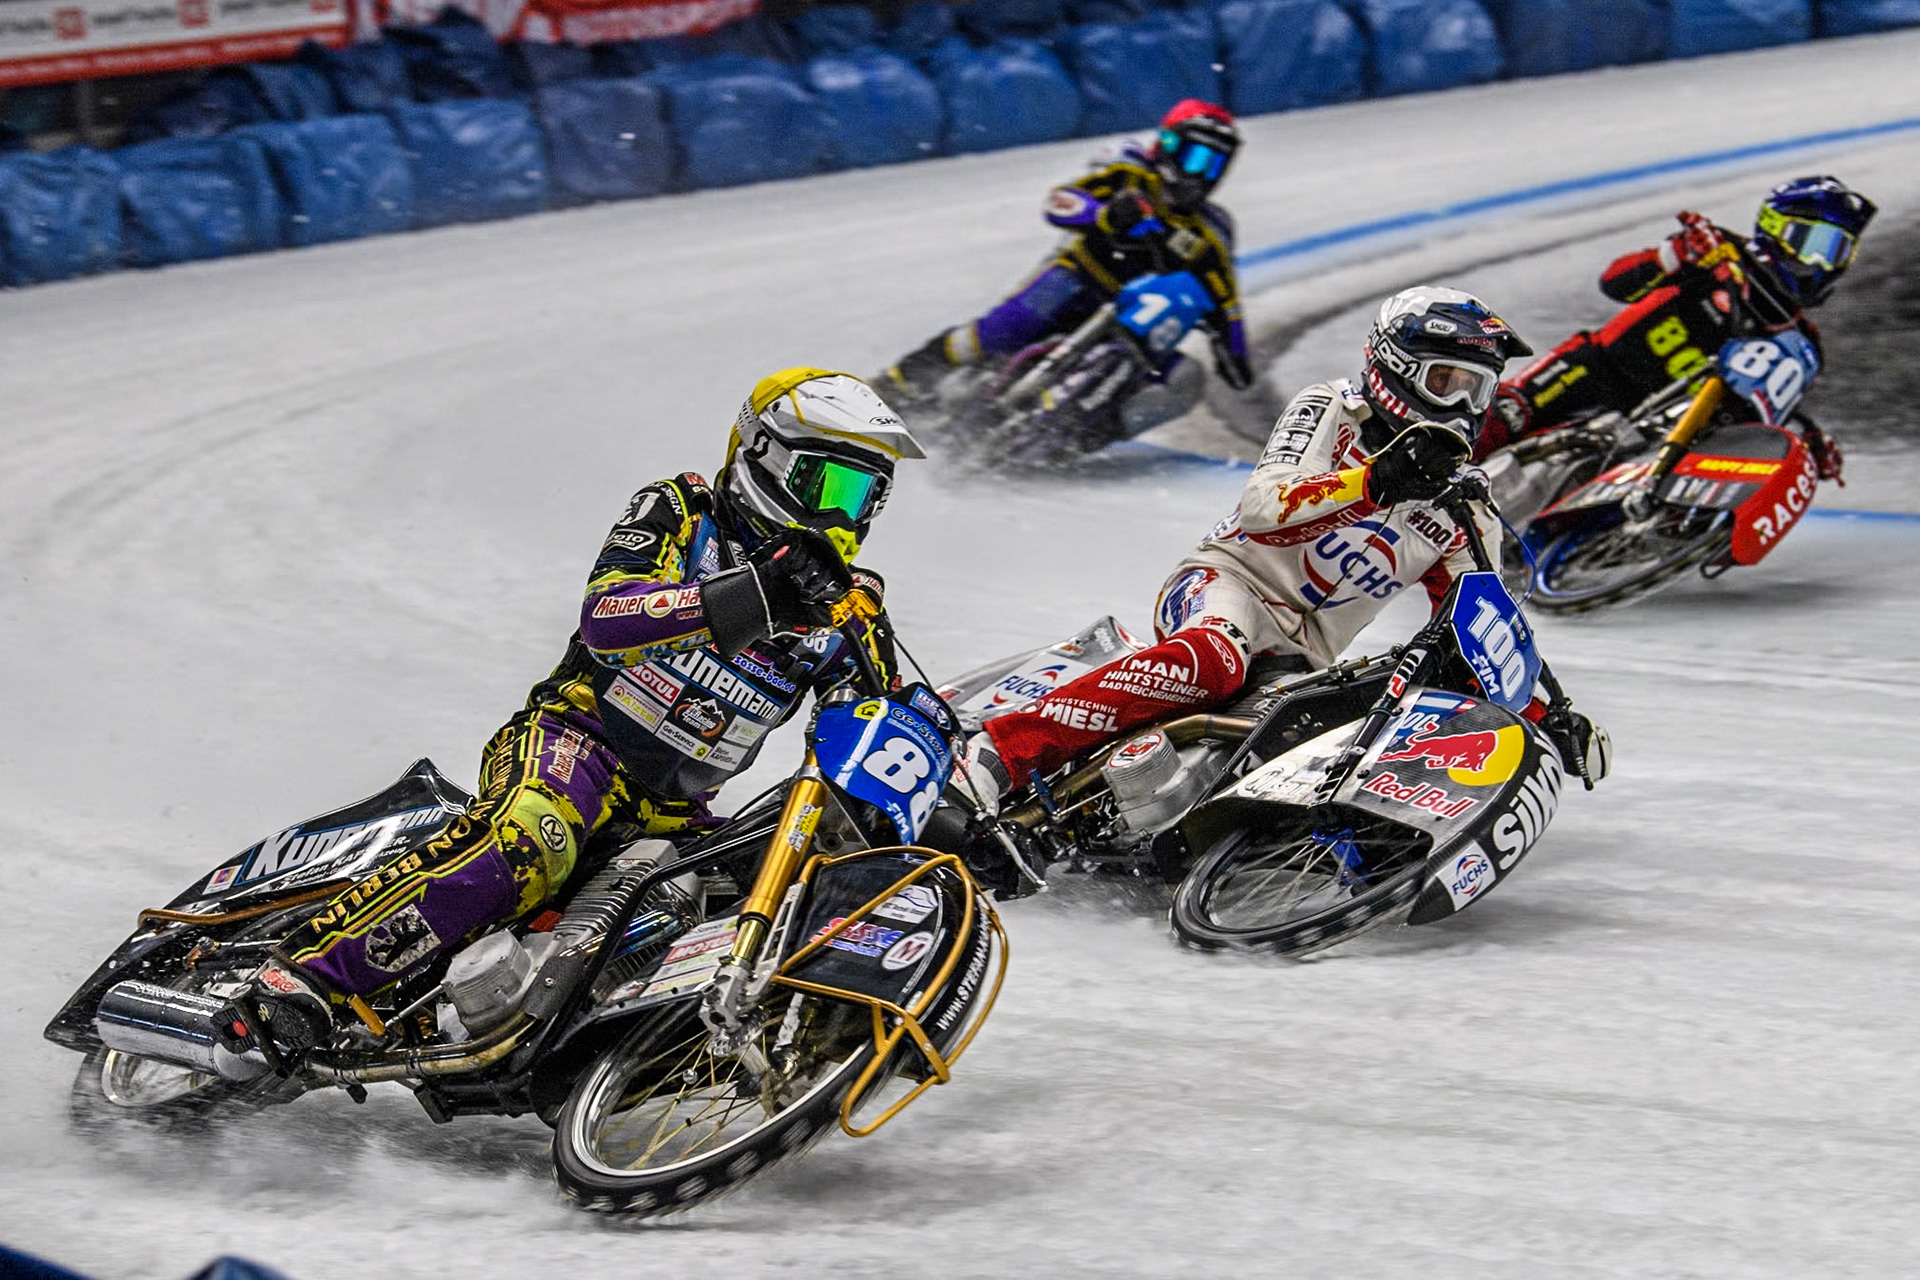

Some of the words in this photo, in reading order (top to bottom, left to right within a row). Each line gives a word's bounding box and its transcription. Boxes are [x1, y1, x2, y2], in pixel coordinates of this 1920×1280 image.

[1730, 341, 1804, 410] 80
[1408, 508, 1453, 547] #100
[1315, 530, 1403, 599] UCHS
[593, 595, 645, 617] Mauer
[1130, 658, 1190, 682] MAN
[1467, 596, 1527, 702] 100
[663, 648, 783, 721] unemann
[996, 675, 1053, 700] FUCHS
[1103, 670, 1209, 698] HINTSTEINER
[1039, 702, 1119, 733] MIESL
[862, 736, 939, 842] 88
[1361, 772, 1431, 802] Red
[1411, 787, 1478, 818] Bull
[310, 852, 422, 934] BERLIN
[1452, 860, 1489, 895] FUCHS
